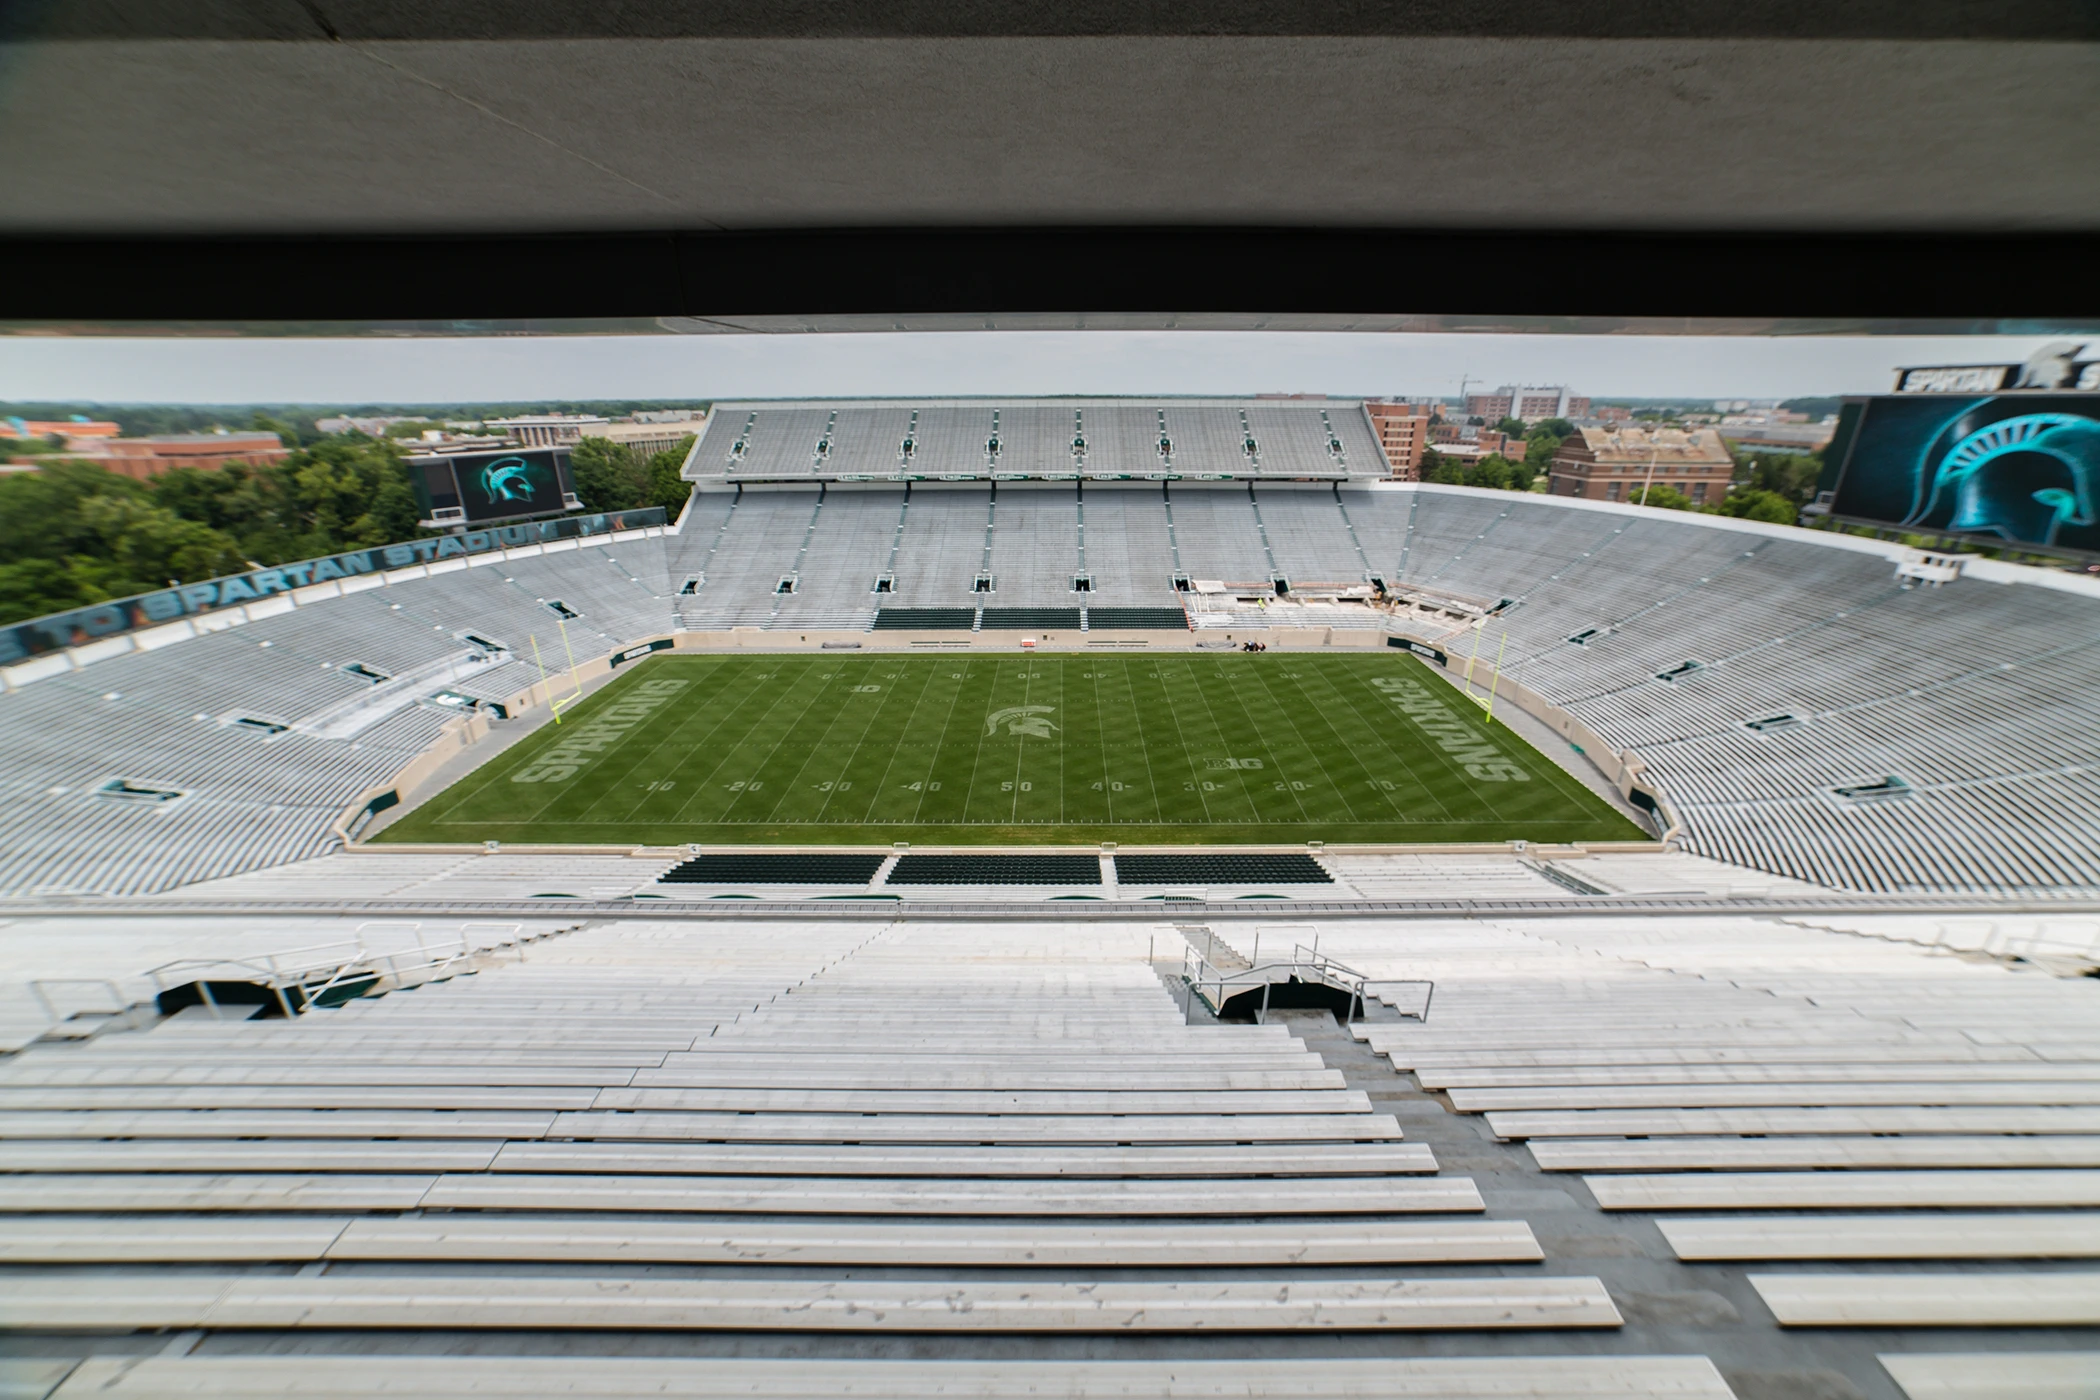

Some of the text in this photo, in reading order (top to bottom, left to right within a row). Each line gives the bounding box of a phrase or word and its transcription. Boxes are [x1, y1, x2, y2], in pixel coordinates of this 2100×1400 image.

[1903, 367, 2001, 393] SPARTAN
[31, 604, 128, 647] TO
[137, 551, 374, 622] SPARTAN
[385, 522, 558, 567] STADIUM
[510, 679, 690, 783] SPARTANS
[1370, 677, 1531, 782] SPARTANS
